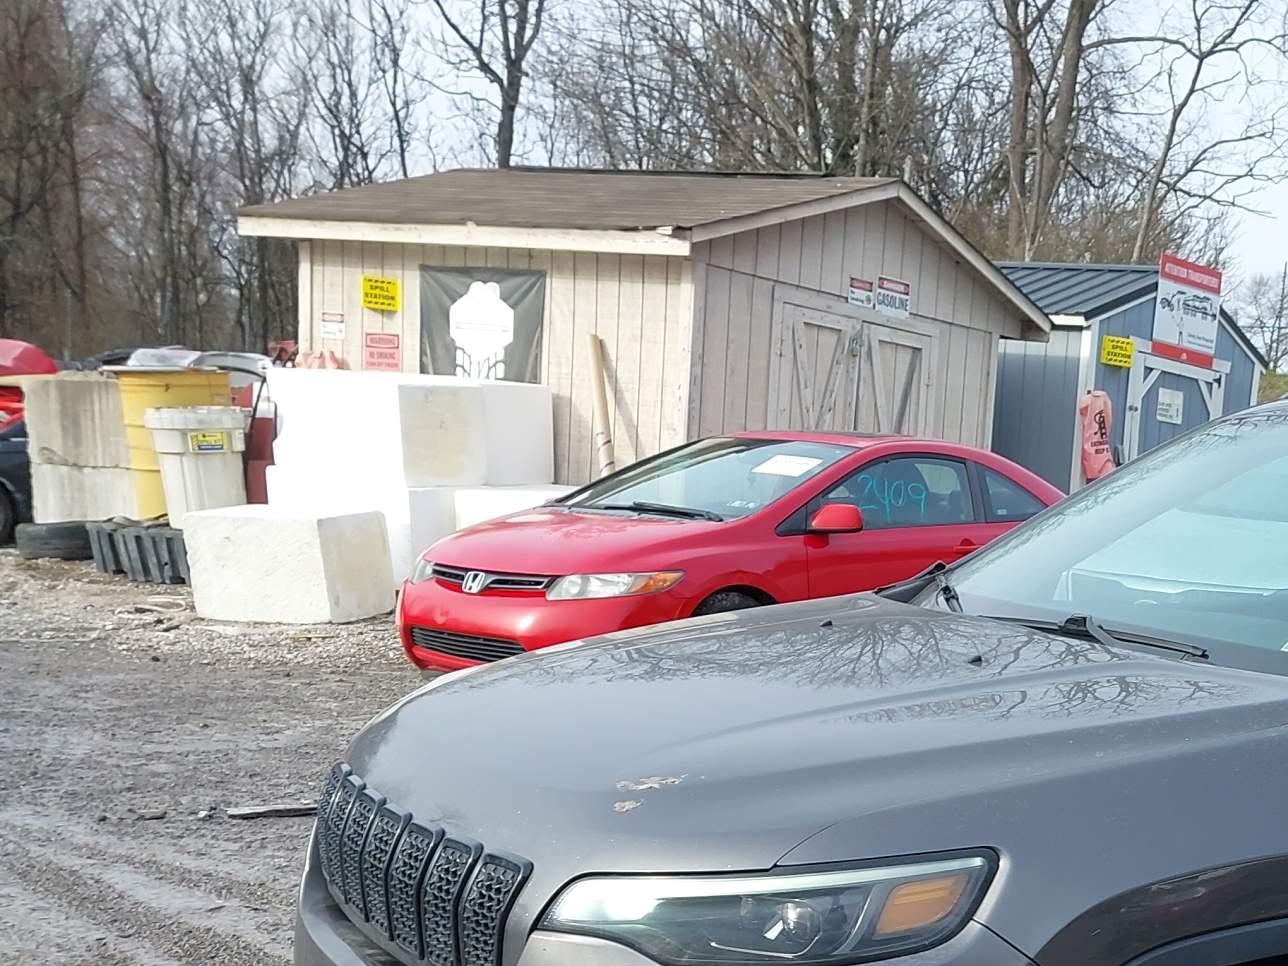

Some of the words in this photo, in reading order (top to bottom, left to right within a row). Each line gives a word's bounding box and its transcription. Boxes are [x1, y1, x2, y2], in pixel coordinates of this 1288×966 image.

[369, 284, 390, 293] SPILL
[364, 291, 396, 301] STATION
[877, 291, 909, 312] GASOLINE
[1111, 344, 1129, 353] SPILL
[1106, 350, 1132, 360] STATION
